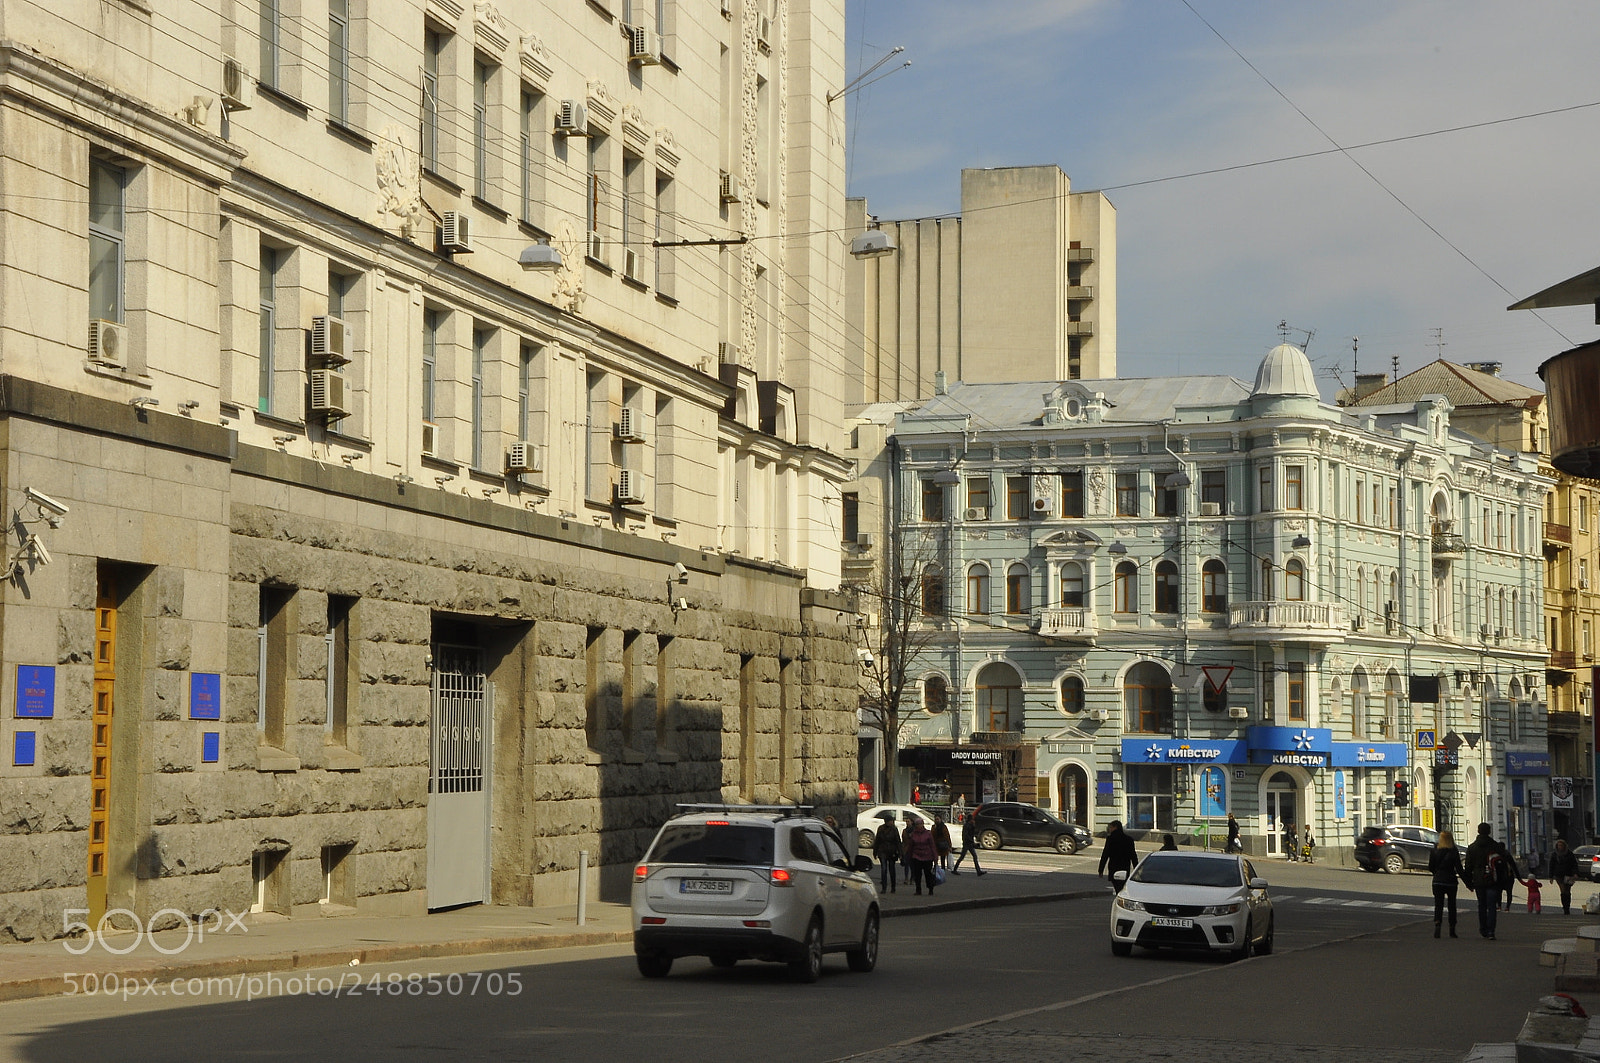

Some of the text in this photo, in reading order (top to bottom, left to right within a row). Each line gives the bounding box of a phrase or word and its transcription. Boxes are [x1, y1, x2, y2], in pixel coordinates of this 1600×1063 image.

[971, 752, 1002, 760] DAUGHTER
[1168, 745, 1221, 758] КИЇВСТАР
[1272, 751, 1324, 765] КИЇВСТАР
[686, 881, 696, 889] AX
